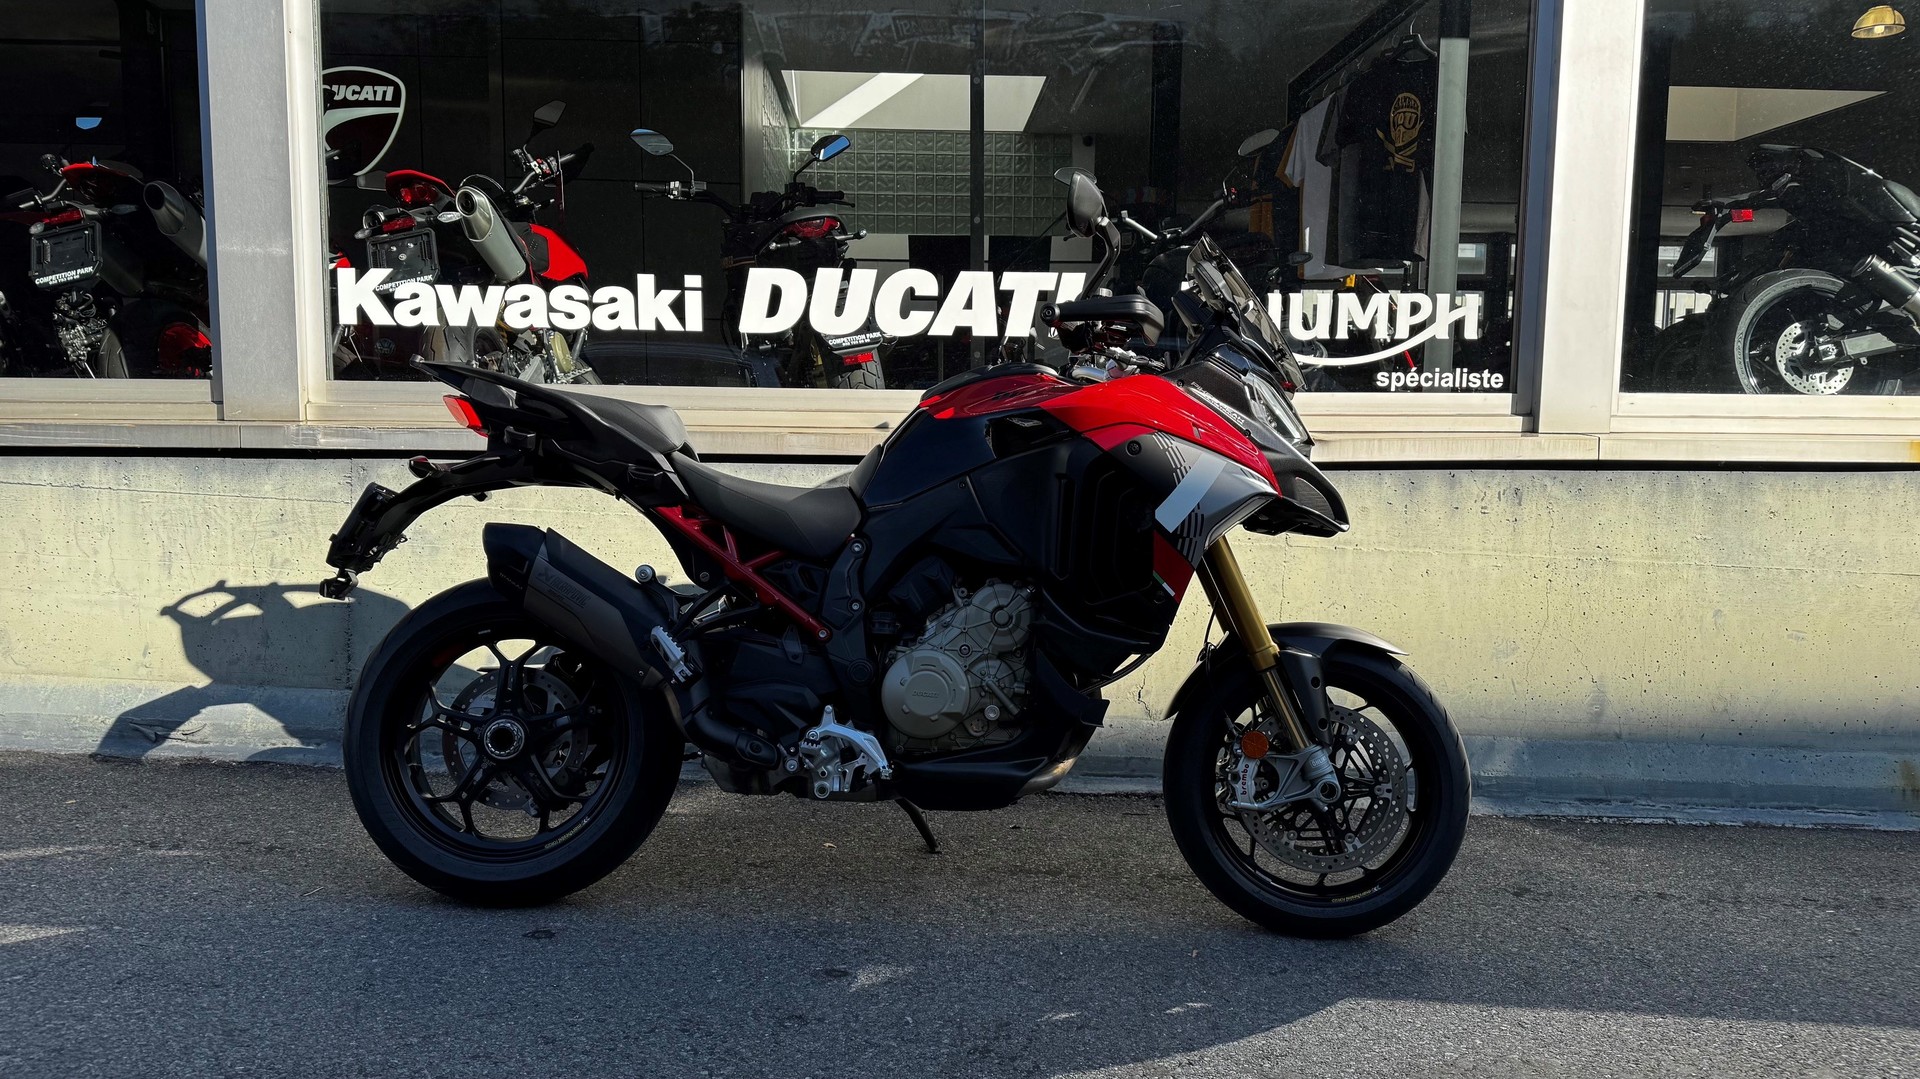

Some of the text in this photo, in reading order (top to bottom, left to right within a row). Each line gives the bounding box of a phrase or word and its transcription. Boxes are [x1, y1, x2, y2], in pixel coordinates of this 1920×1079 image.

[322, 85, 394, 101] UCATI
[337, 267, 703, 332] Kawasaki
[1376, 367, 1504, 391] spécialiste
[1240, 763, 1250, 796] brembo
